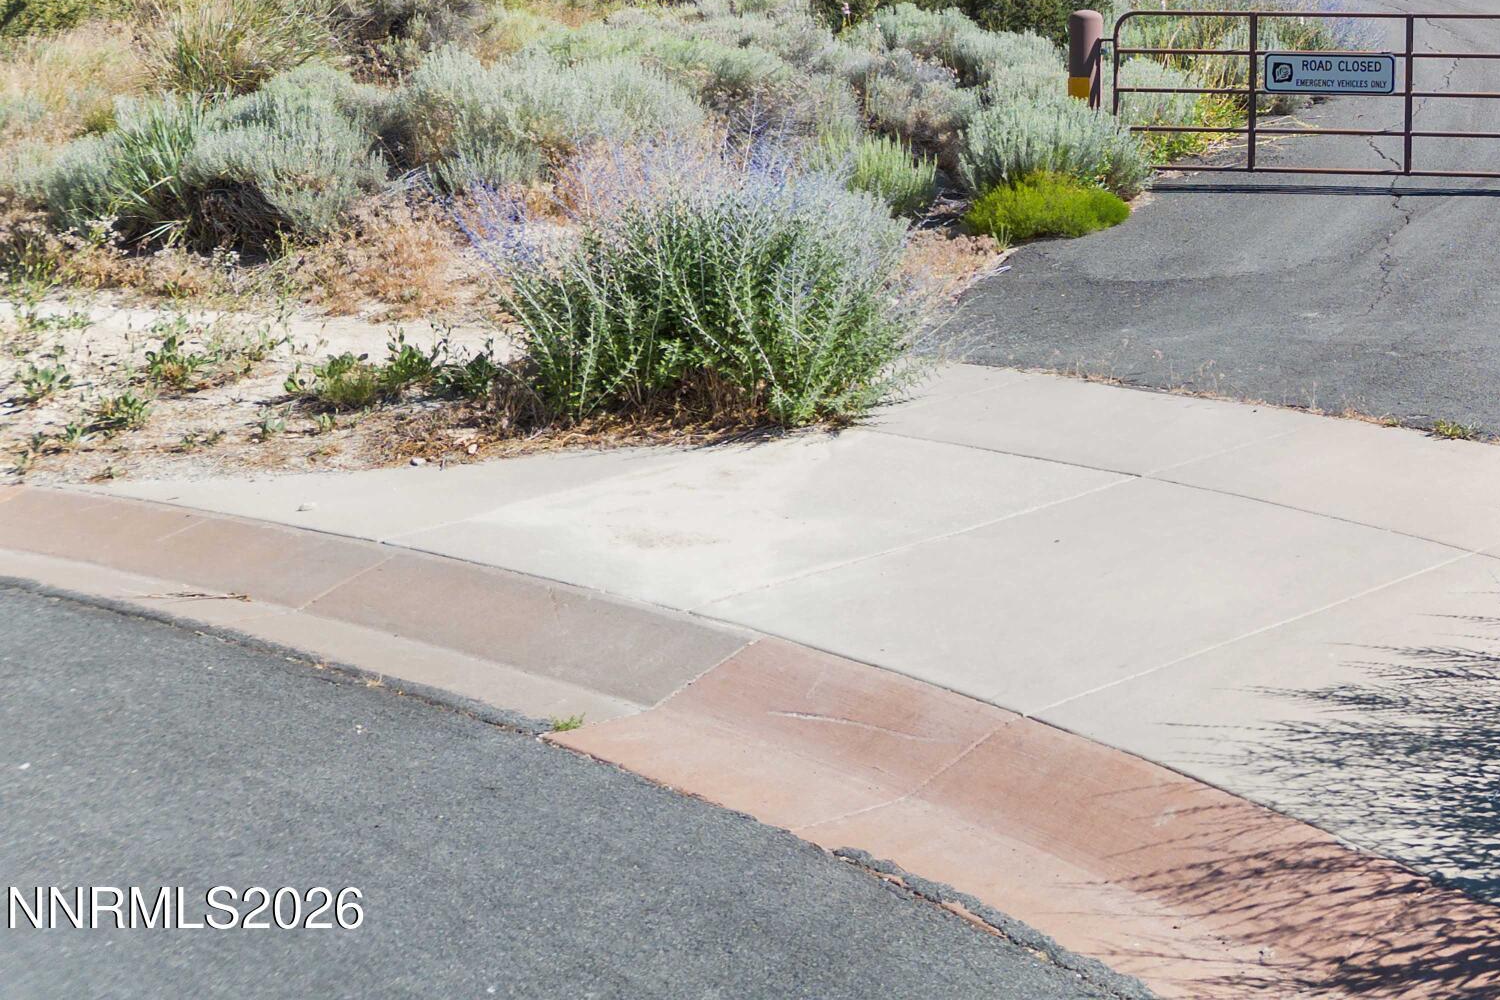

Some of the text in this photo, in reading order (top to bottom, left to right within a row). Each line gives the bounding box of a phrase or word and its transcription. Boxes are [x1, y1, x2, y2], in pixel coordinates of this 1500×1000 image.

[1301, 60, 1382, 73] ROAD CLOSED
[1295, 78, 1388, 89] EMERGENCY VEHICLES ONLY
